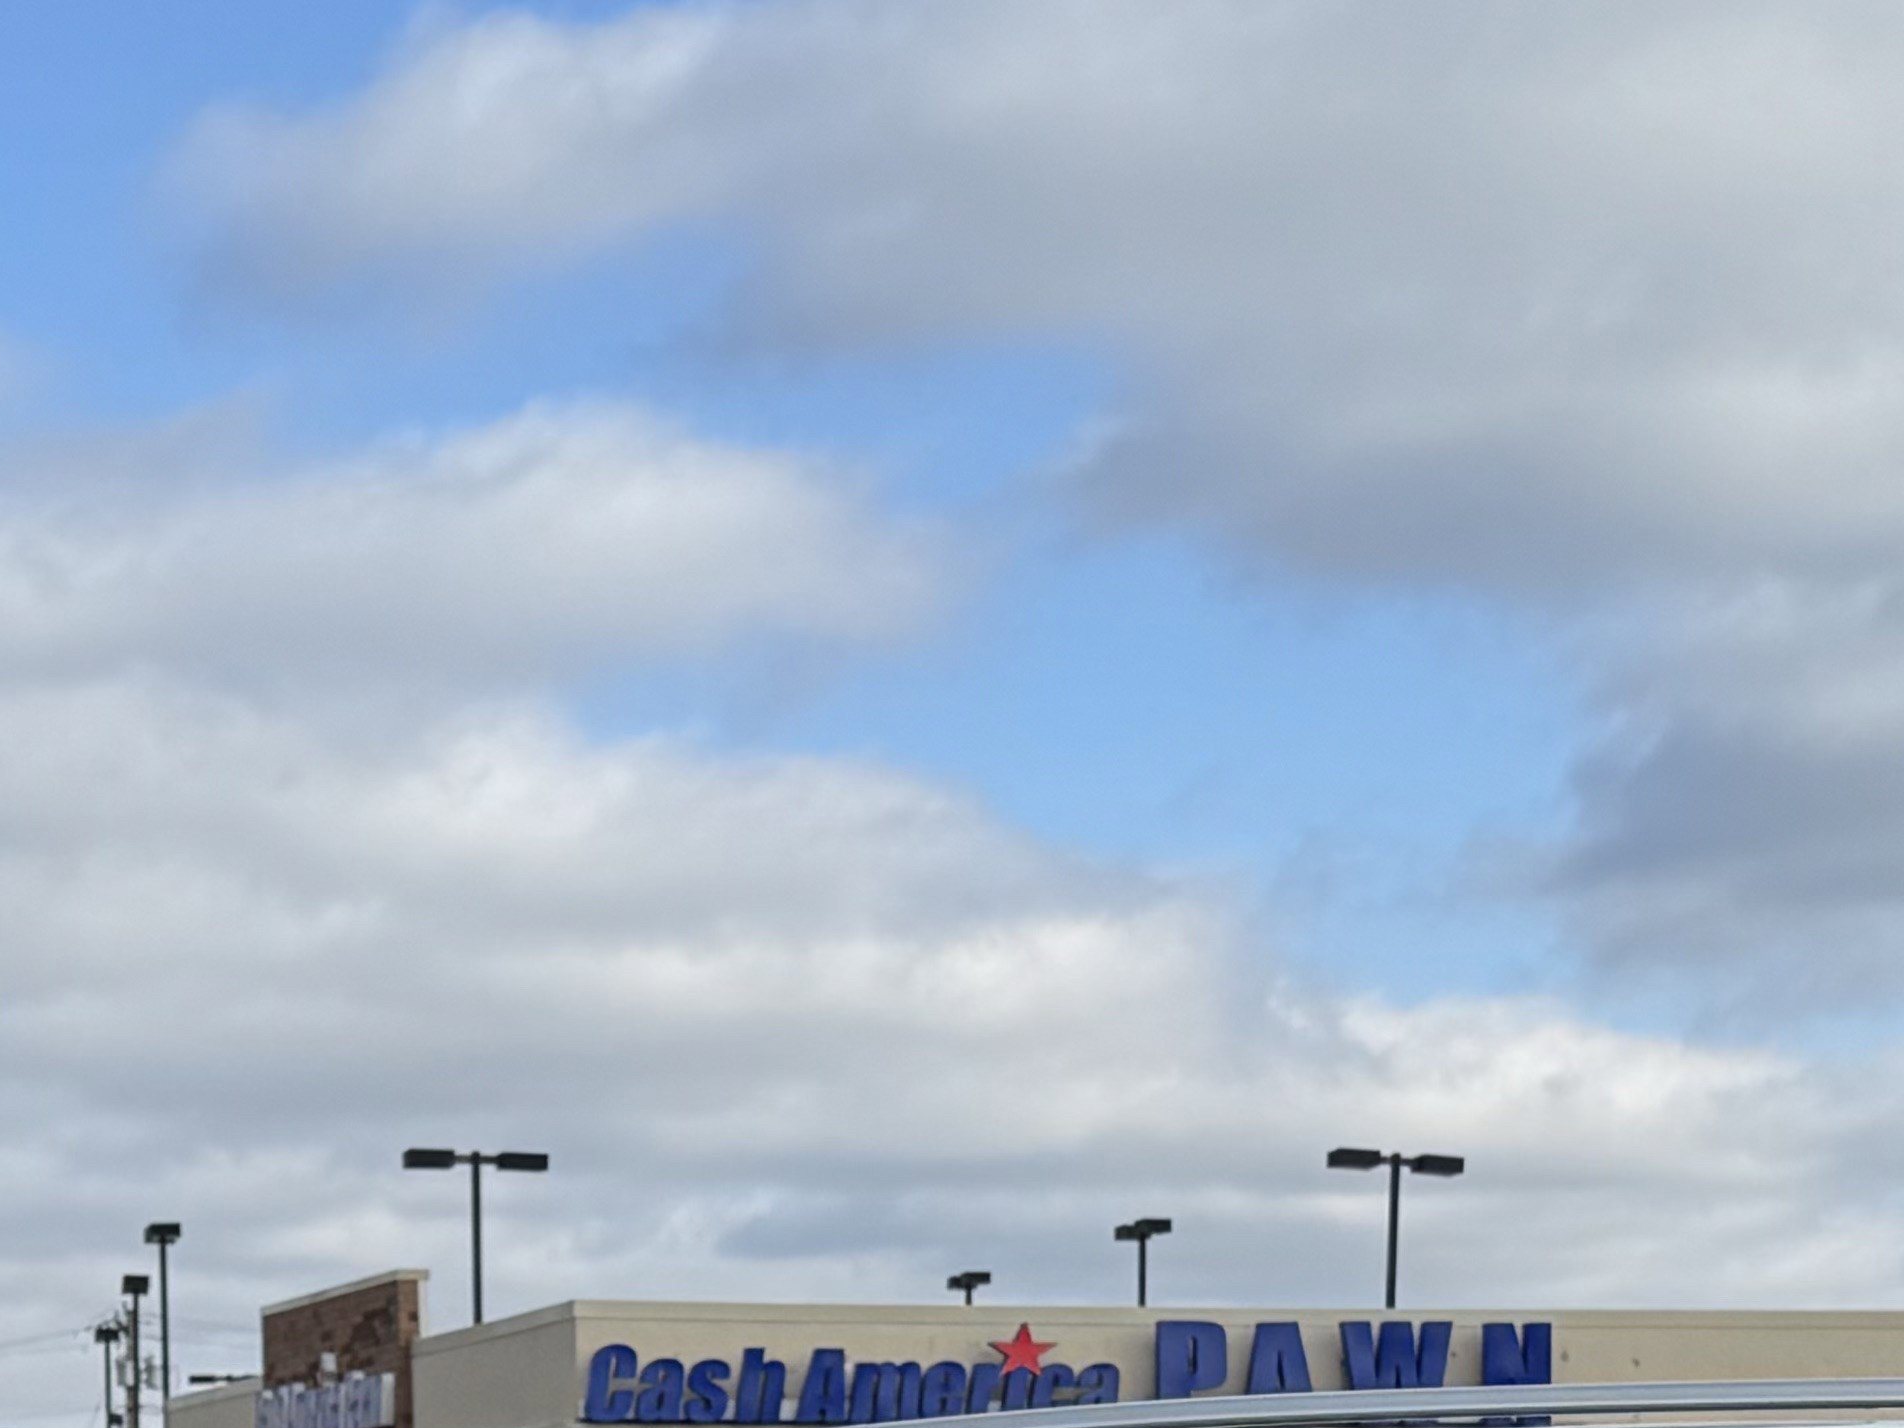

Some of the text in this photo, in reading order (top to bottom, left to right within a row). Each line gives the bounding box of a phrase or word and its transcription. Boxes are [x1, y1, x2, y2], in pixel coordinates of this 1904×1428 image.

[583, 1320, 1553, 1427] Cash America PAWN
